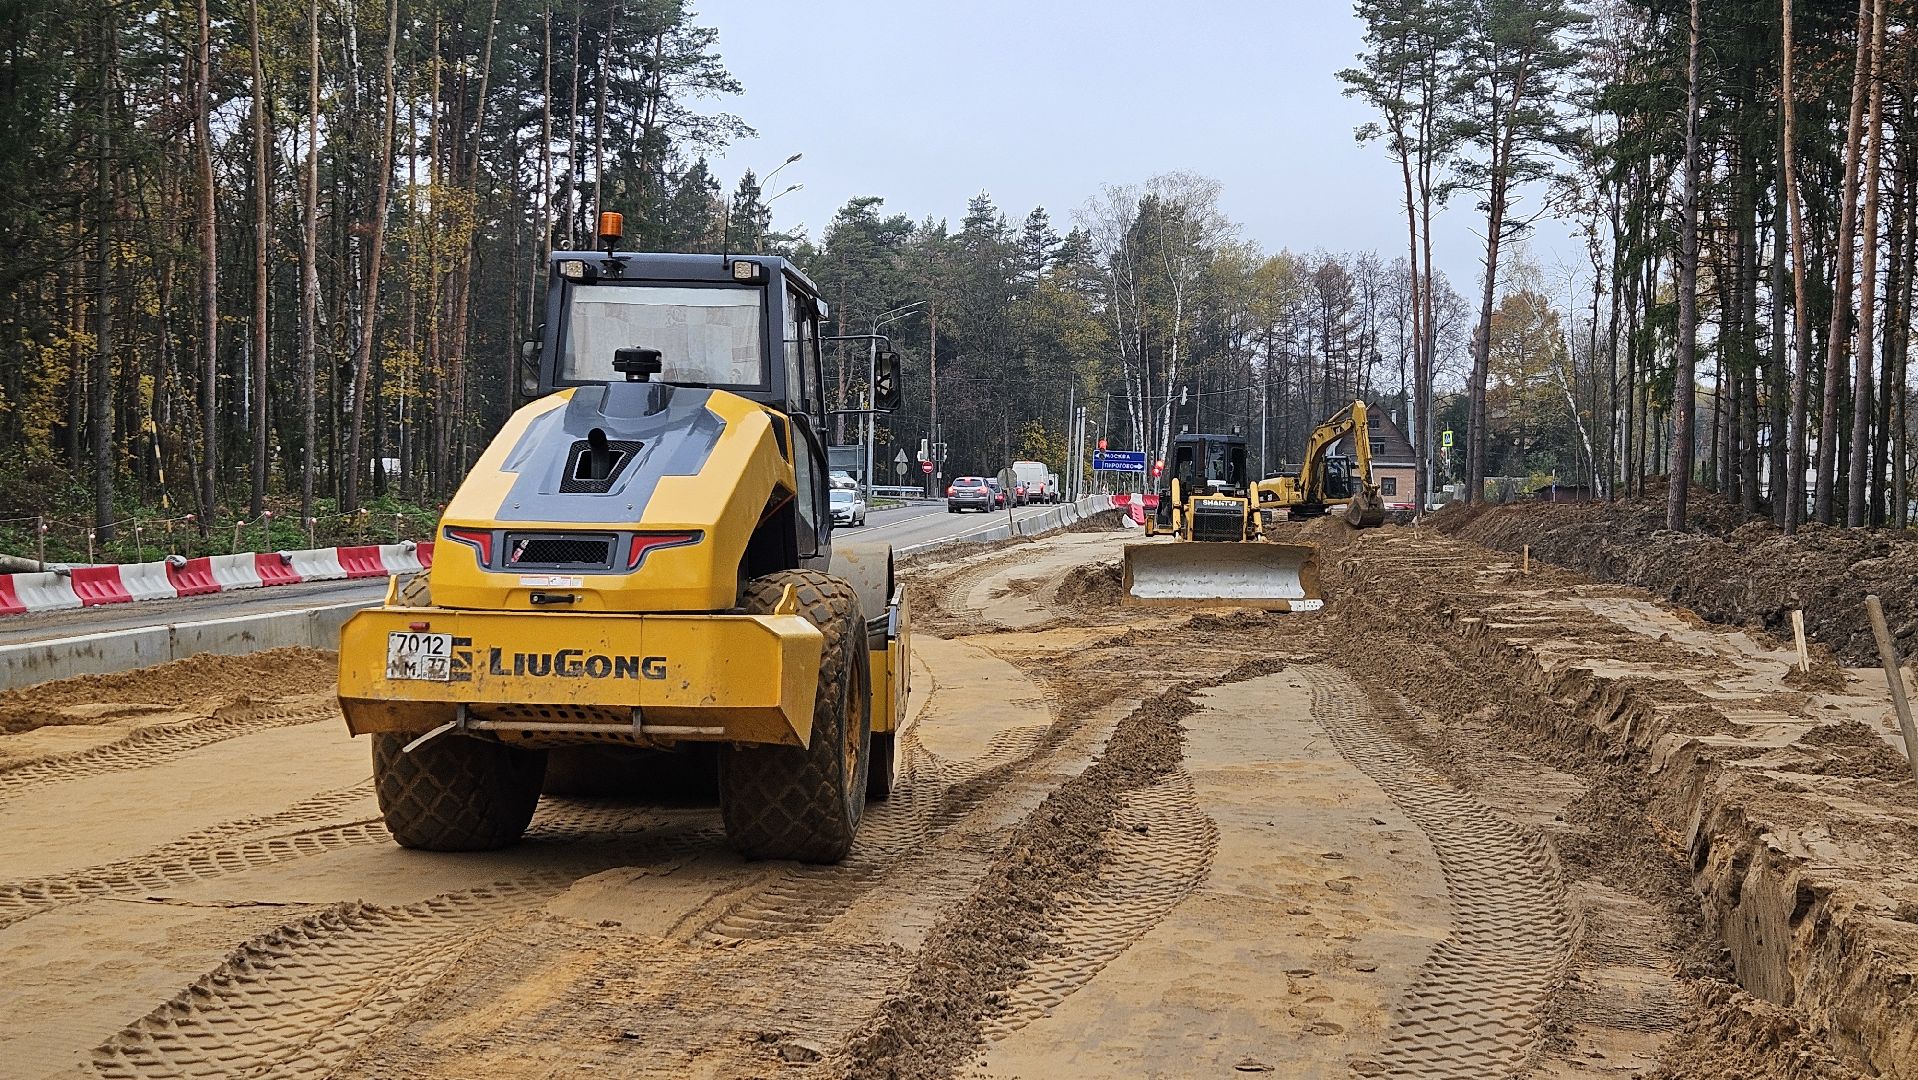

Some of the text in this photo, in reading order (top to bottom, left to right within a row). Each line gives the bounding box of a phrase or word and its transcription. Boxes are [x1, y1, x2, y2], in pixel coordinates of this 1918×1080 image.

[1202, 499, 1237, 507] SHANTUI
[398, 634, 444, 655] 7012
[428, 658, 446, 673] 77
